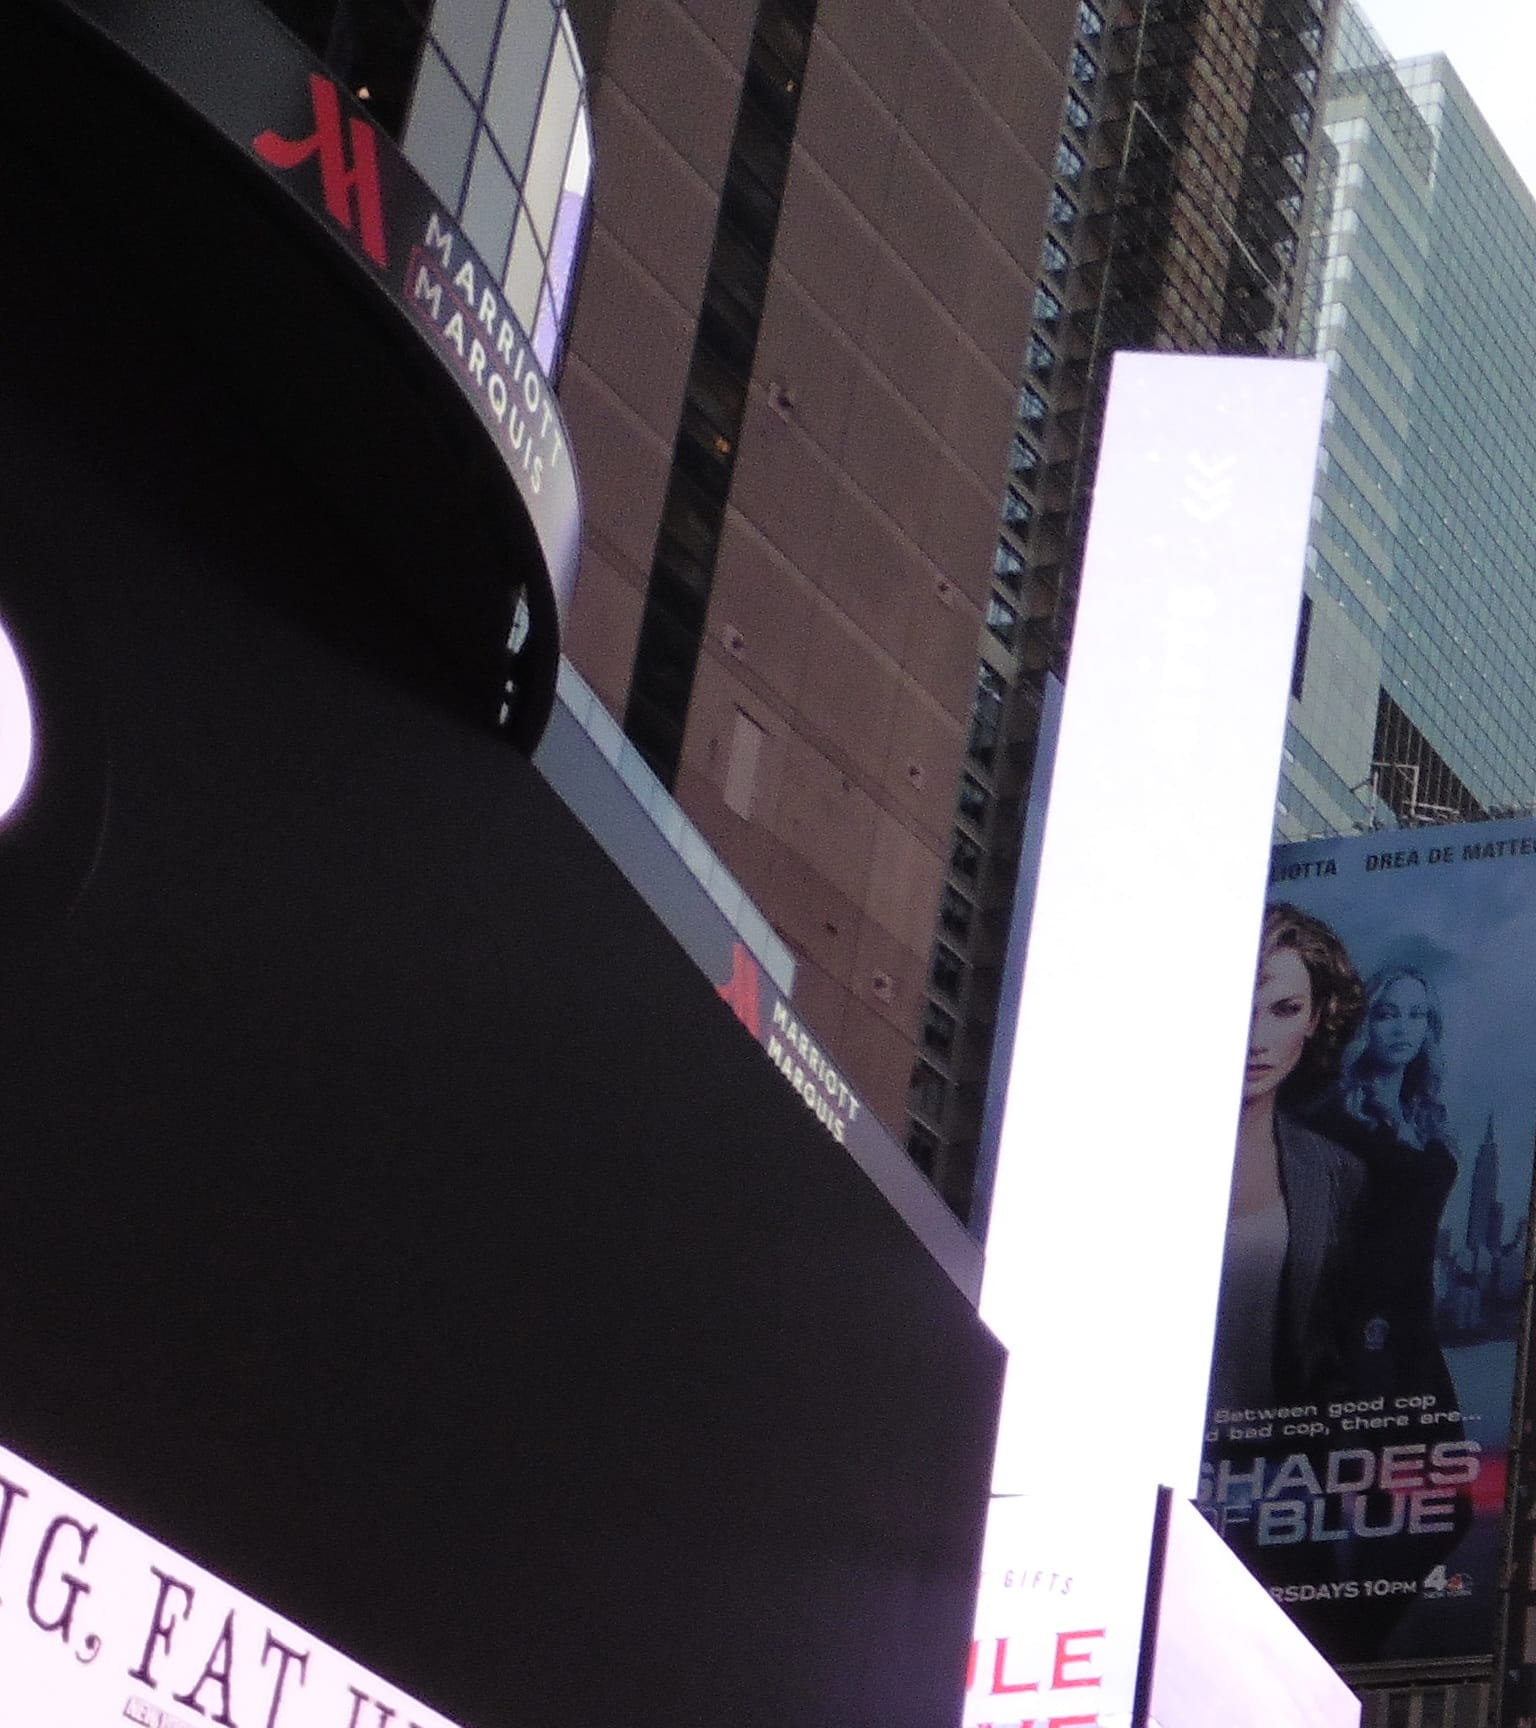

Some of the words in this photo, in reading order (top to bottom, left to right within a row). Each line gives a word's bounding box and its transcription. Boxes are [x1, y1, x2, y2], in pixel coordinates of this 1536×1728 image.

[413, 266, 545, 494] MARQUIS
[425, 213, 565, 468] MARRIOTT
[767, 1034, 846, 1144] MARQUIS
[773, 1001, 860, 1120] MARRIOTT
[1328, 1398, 1385, 1418] good
[1395, 1394, 1437, 1411] cop
[1341, 1411, 1409, 1431] there
[1257, 1488, 1457, 1547] BLUE
[1003, 1569, 1074, 1597] GIFTS
